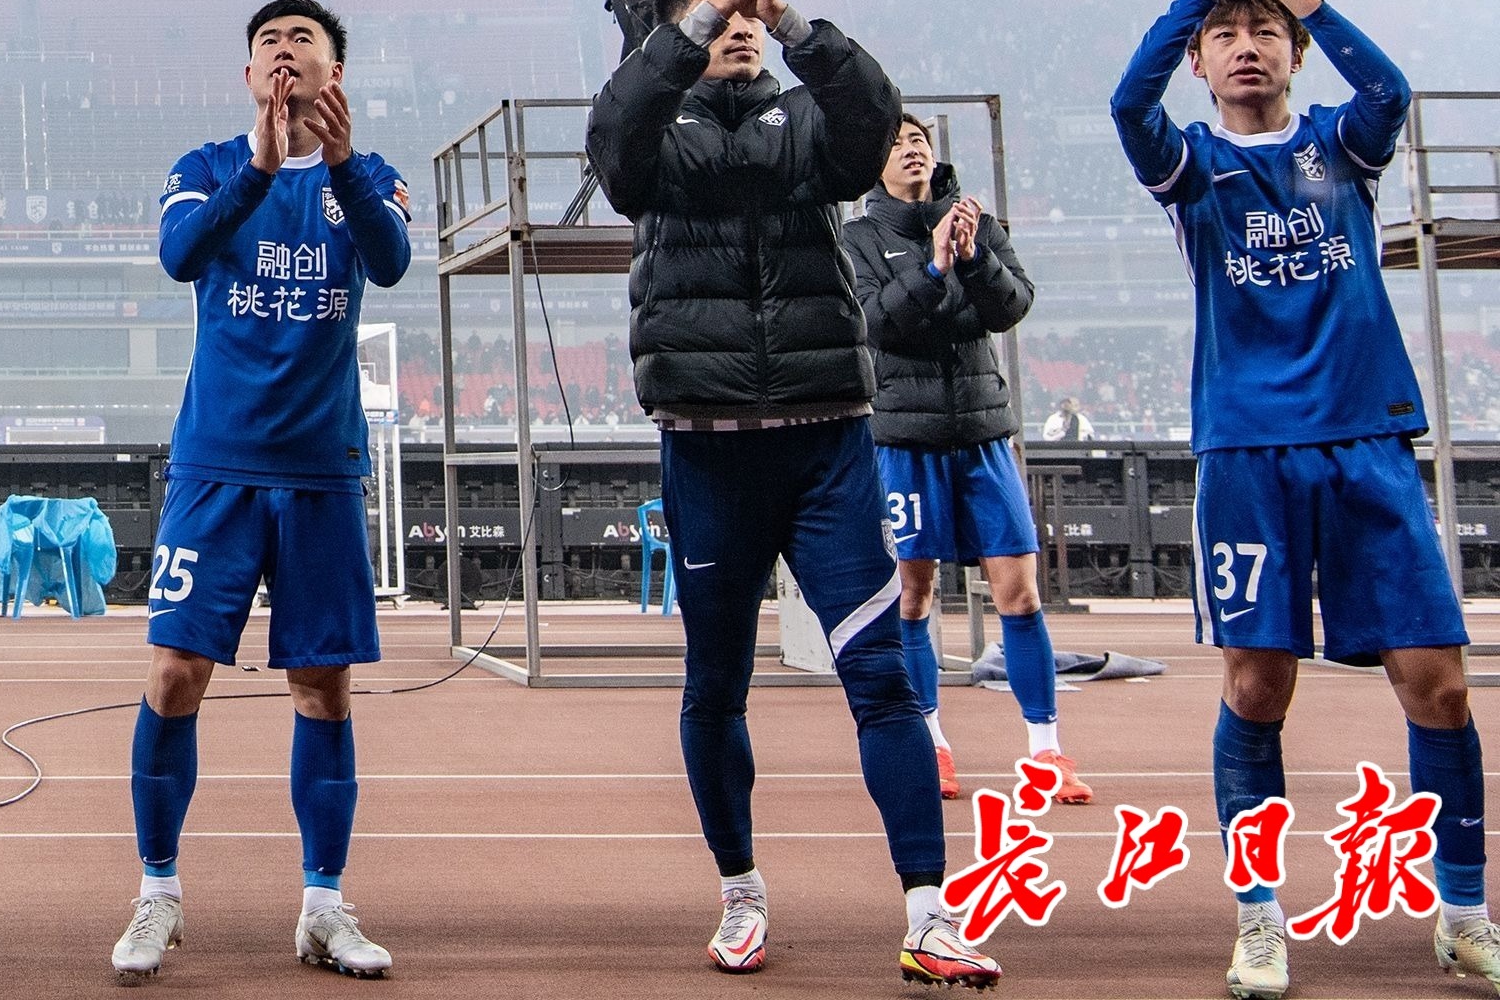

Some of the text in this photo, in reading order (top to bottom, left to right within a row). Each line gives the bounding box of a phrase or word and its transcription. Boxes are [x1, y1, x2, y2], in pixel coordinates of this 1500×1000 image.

[1245, 202, 1325, 249] 融创
[256, 240, 327, 281] 融创
[1224, 235, 1356, 288] 桃花源
[227, 281, 350, 322] 桃花源
[408, 522, 505, 543] Absn 艾比森
[887, 492, 922, 530] 31
[149, 544, 199, 602] 25
[1213, 541, 1268, 602] 37
